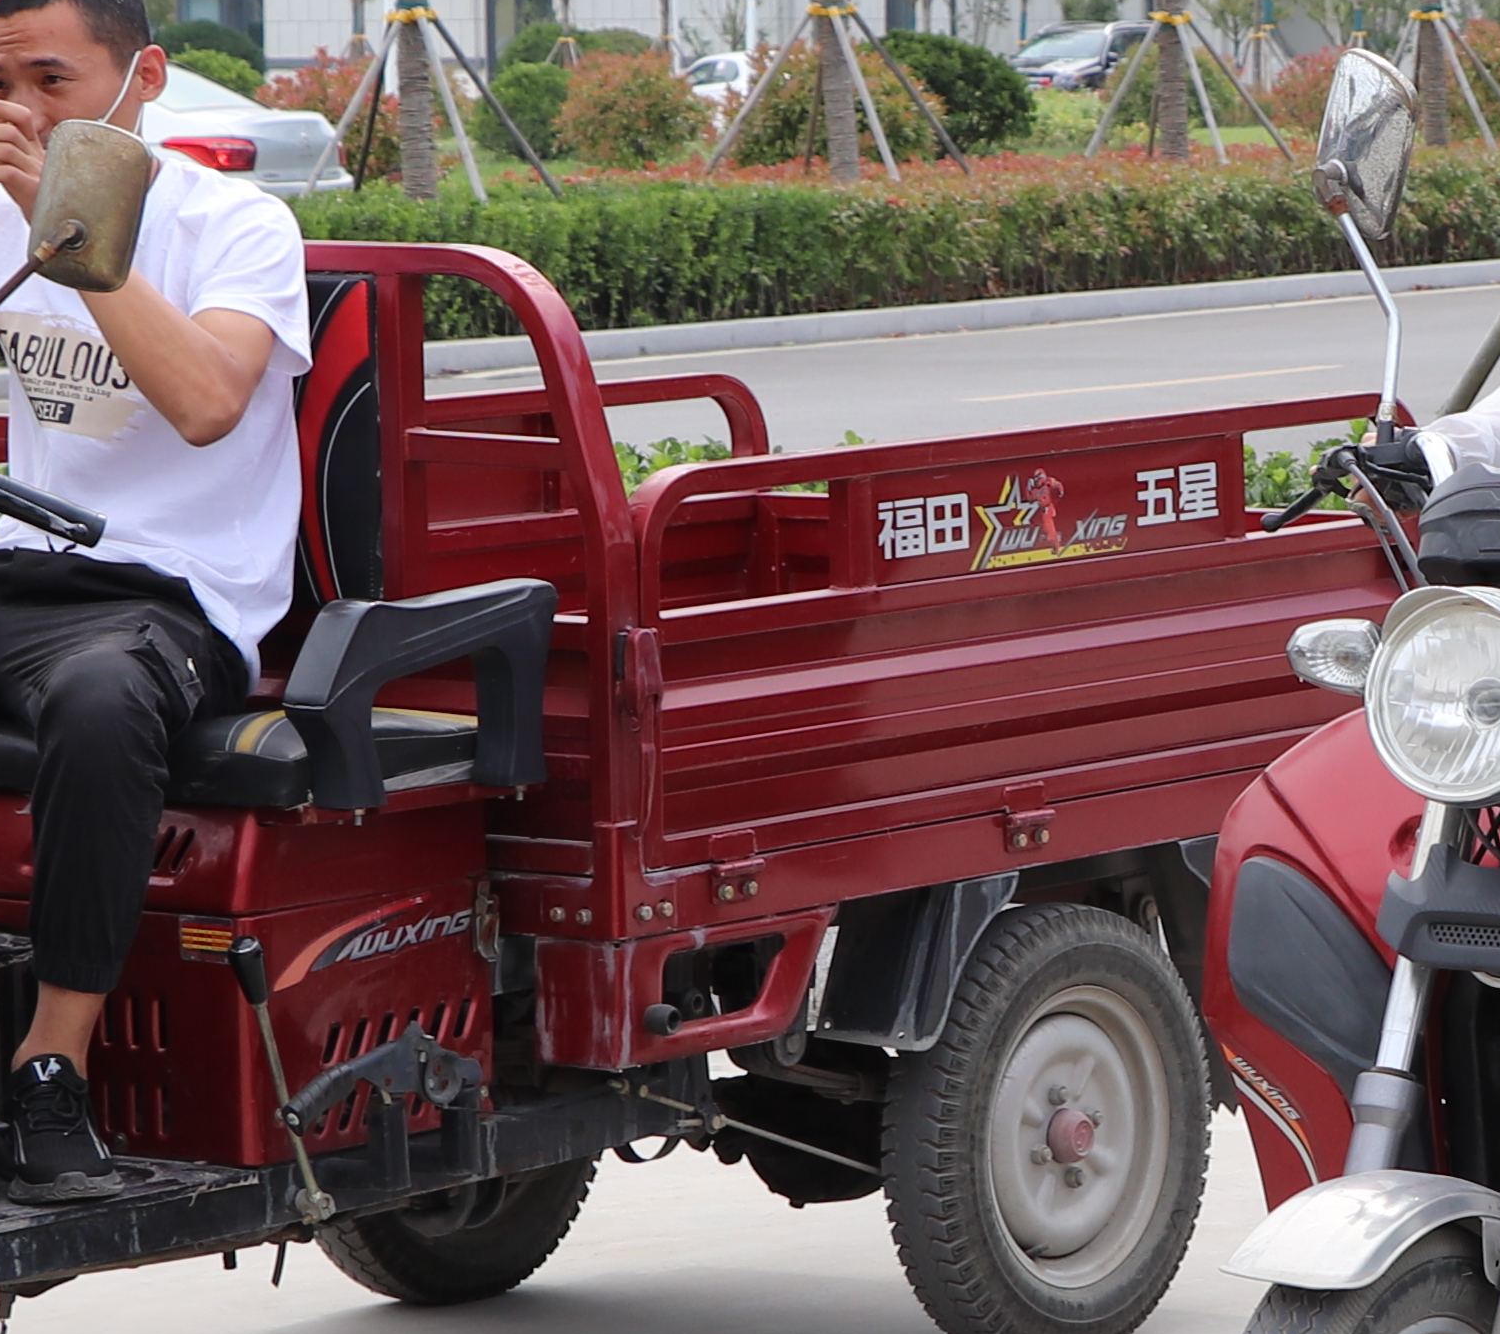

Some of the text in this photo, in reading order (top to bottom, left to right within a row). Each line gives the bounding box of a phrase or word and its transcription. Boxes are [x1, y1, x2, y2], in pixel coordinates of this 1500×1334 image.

[876, 492, 971, 561] 福田
[1135, 461, 1220, 529] 五星
[342, 910, 473, 961] WUXING
[1232, 1056, 1301, 1121] WUXING
